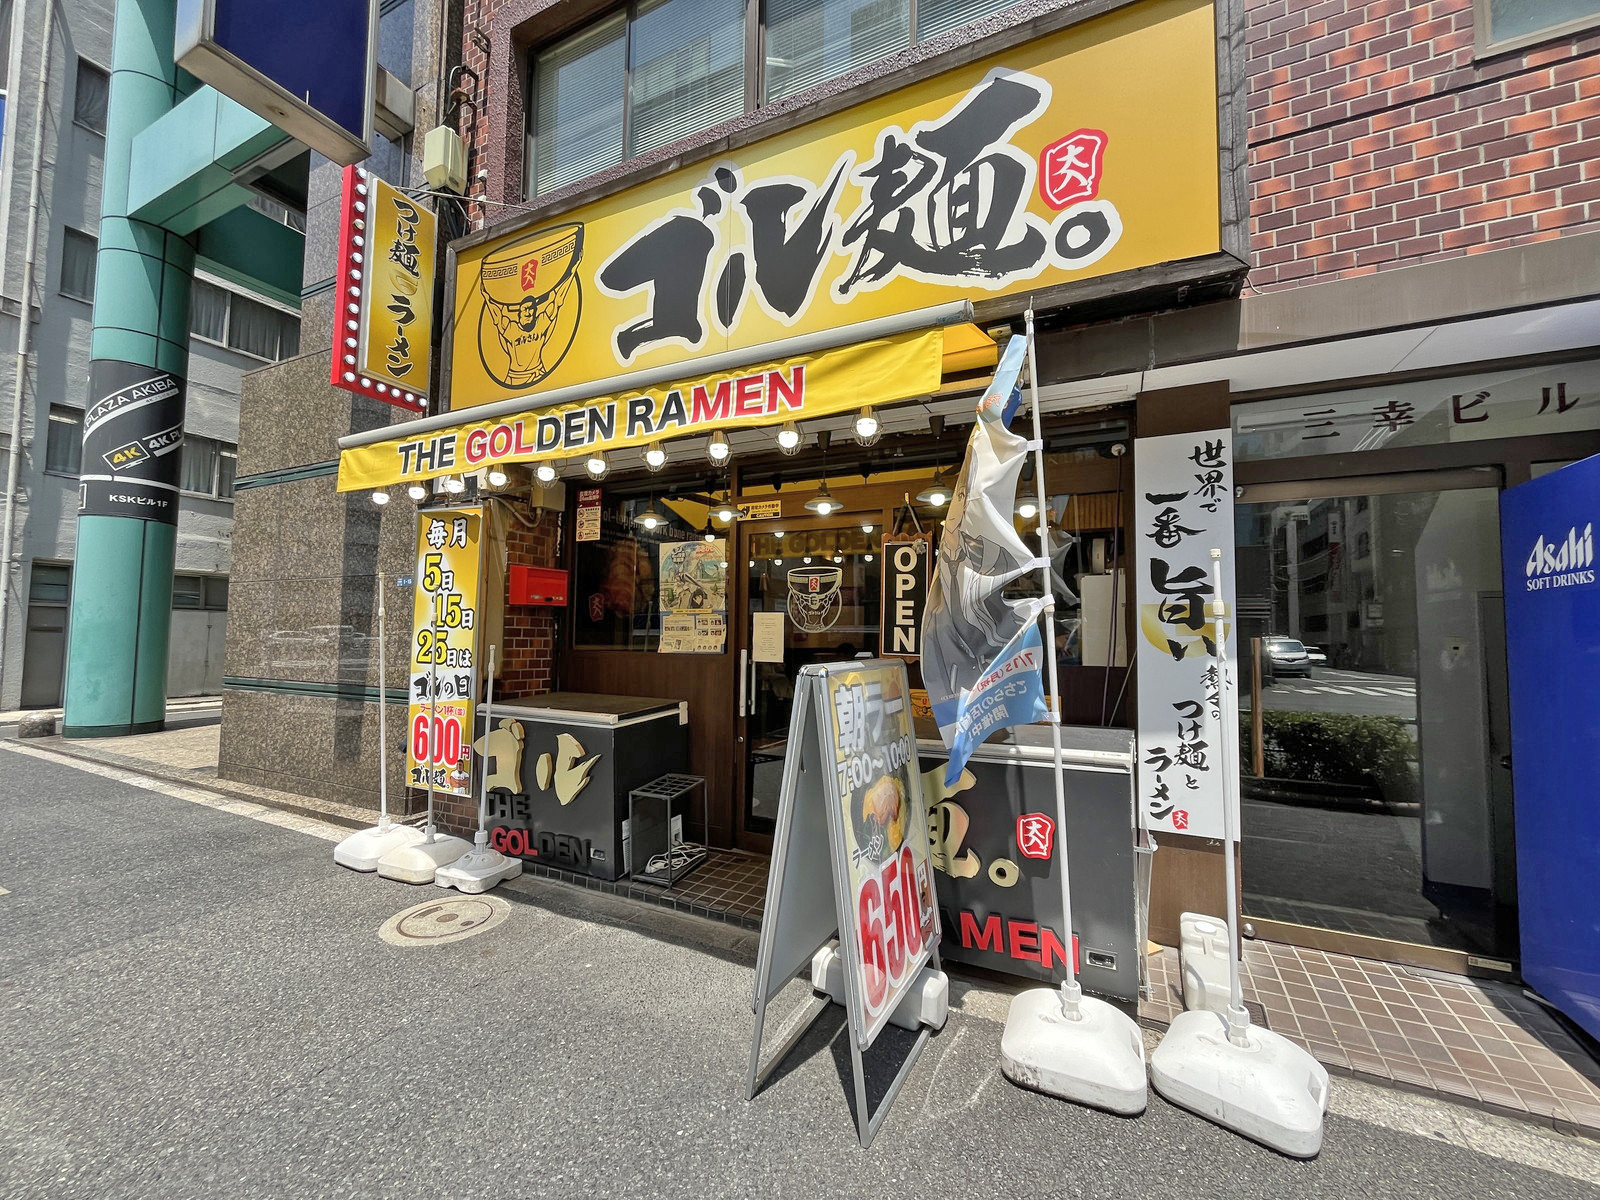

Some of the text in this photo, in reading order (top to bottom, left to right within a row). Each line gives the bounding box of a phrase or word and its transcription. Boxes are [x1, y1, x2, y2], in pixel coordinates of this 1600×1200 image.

[385, 197, 422, 378] つけ麺 ラーメン
[86, 395, 130, 428] PLAZA
[132, 378, 176, 400] AKIBA
[399, 366, 805, 475] THE GOLDEN RAMEN
[1301, 382, 1580, 442] 三幸ビル
[112, 446, 142, 464] 4K
[149, 428, 184, 449] 4K PL
[1188, 438, 1227, 513] 世界で
[109, 494, 168, 508] KSKビル1F
[426, 517, 467, 549] 毎月
[1526, 522, 1594, 577] Asahi
[423, 553, 454, 592] 5日
[1526, 570, 1595, 592] SOFT DRINKS
[431, 593, 474, 630] 15日
[893, 546, 917, 653] OPEN
[416, 629, 473, 668] 25日は
[413, 715, 470, 766] 600円
[834, 680, 904, 758] 朝ラー
[472, 718, 602, 806] ゴル
[1172, 700, 1210, 790] つけ麺と
[484, 794, 531, 820] THE
[1144, 747, 1175, 820] ラーメン
[491, 826, 592, 865] GOLDEN
[852, 834, 884, 869] ラーメン
